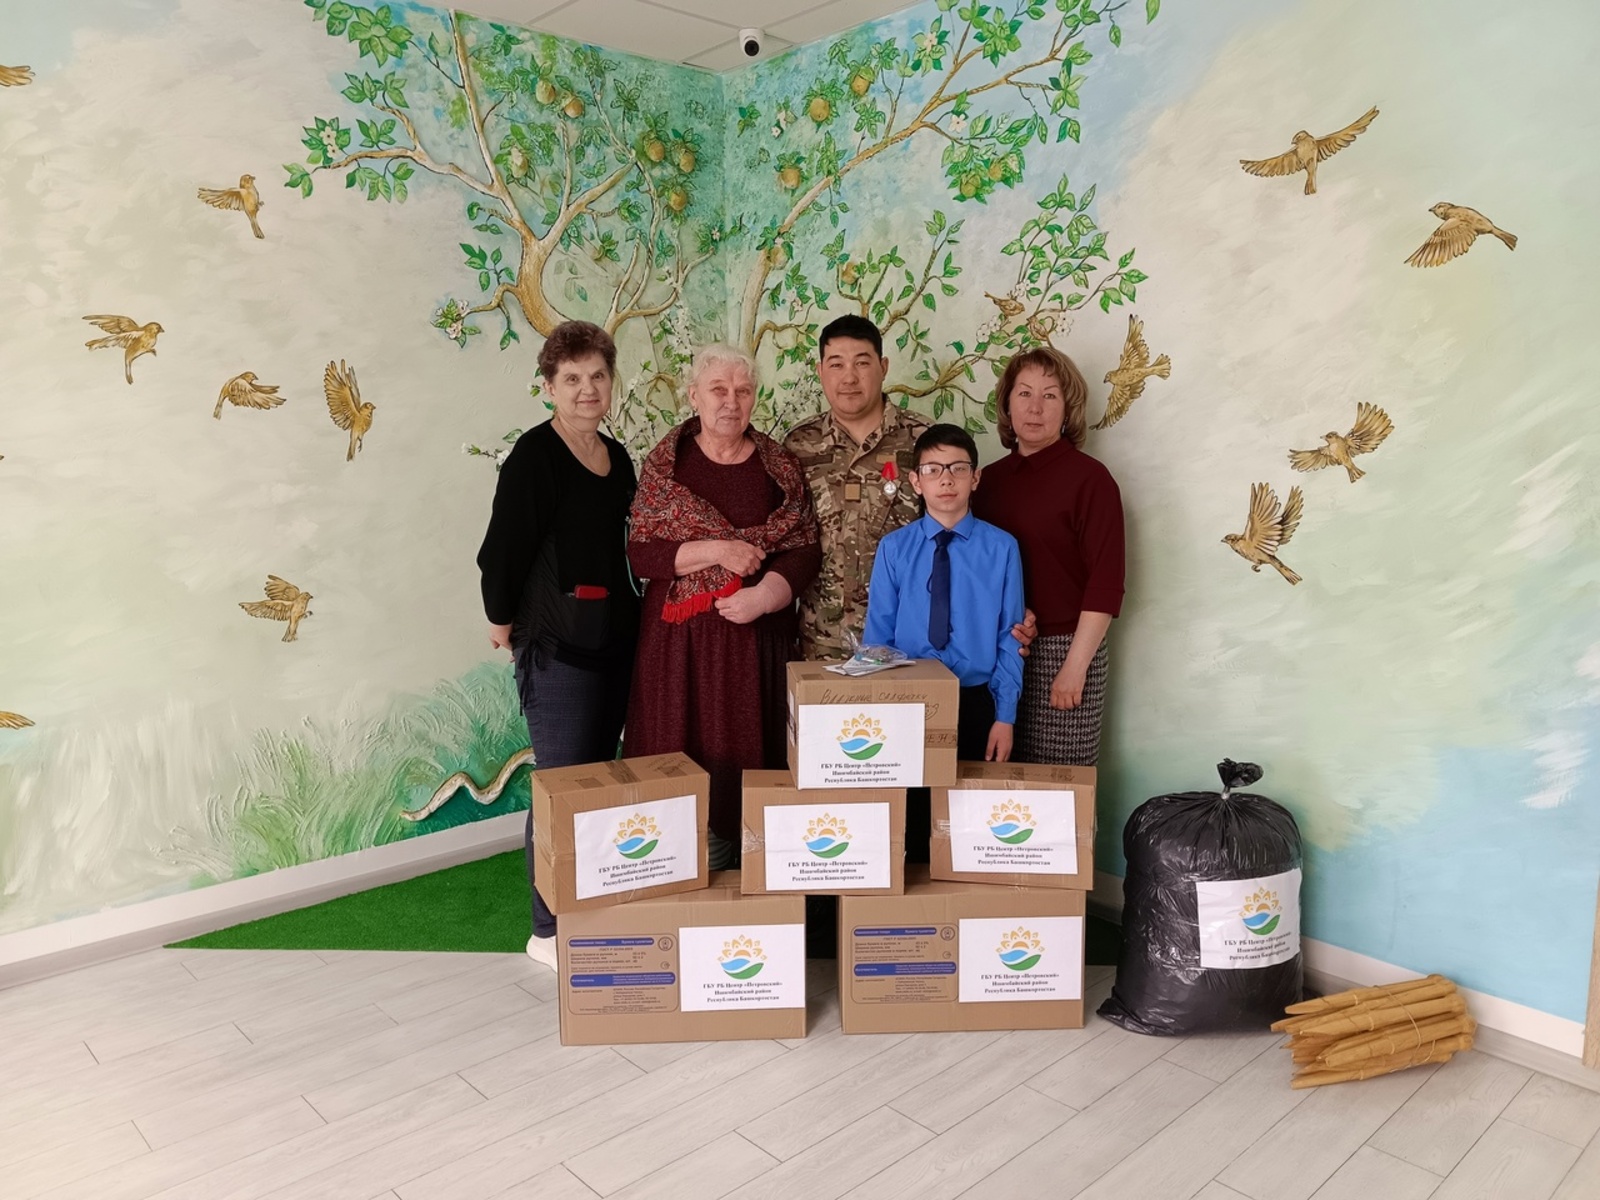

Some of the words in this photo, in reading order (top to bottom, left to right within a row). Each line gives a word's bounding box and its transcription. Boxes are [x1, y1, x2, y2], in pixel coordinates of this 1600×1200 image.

[602, 877, 634, 887] Республика
[635, 870, 673, 880] Башкортостан
[610, 868, 649, 878] Ишимбайский
